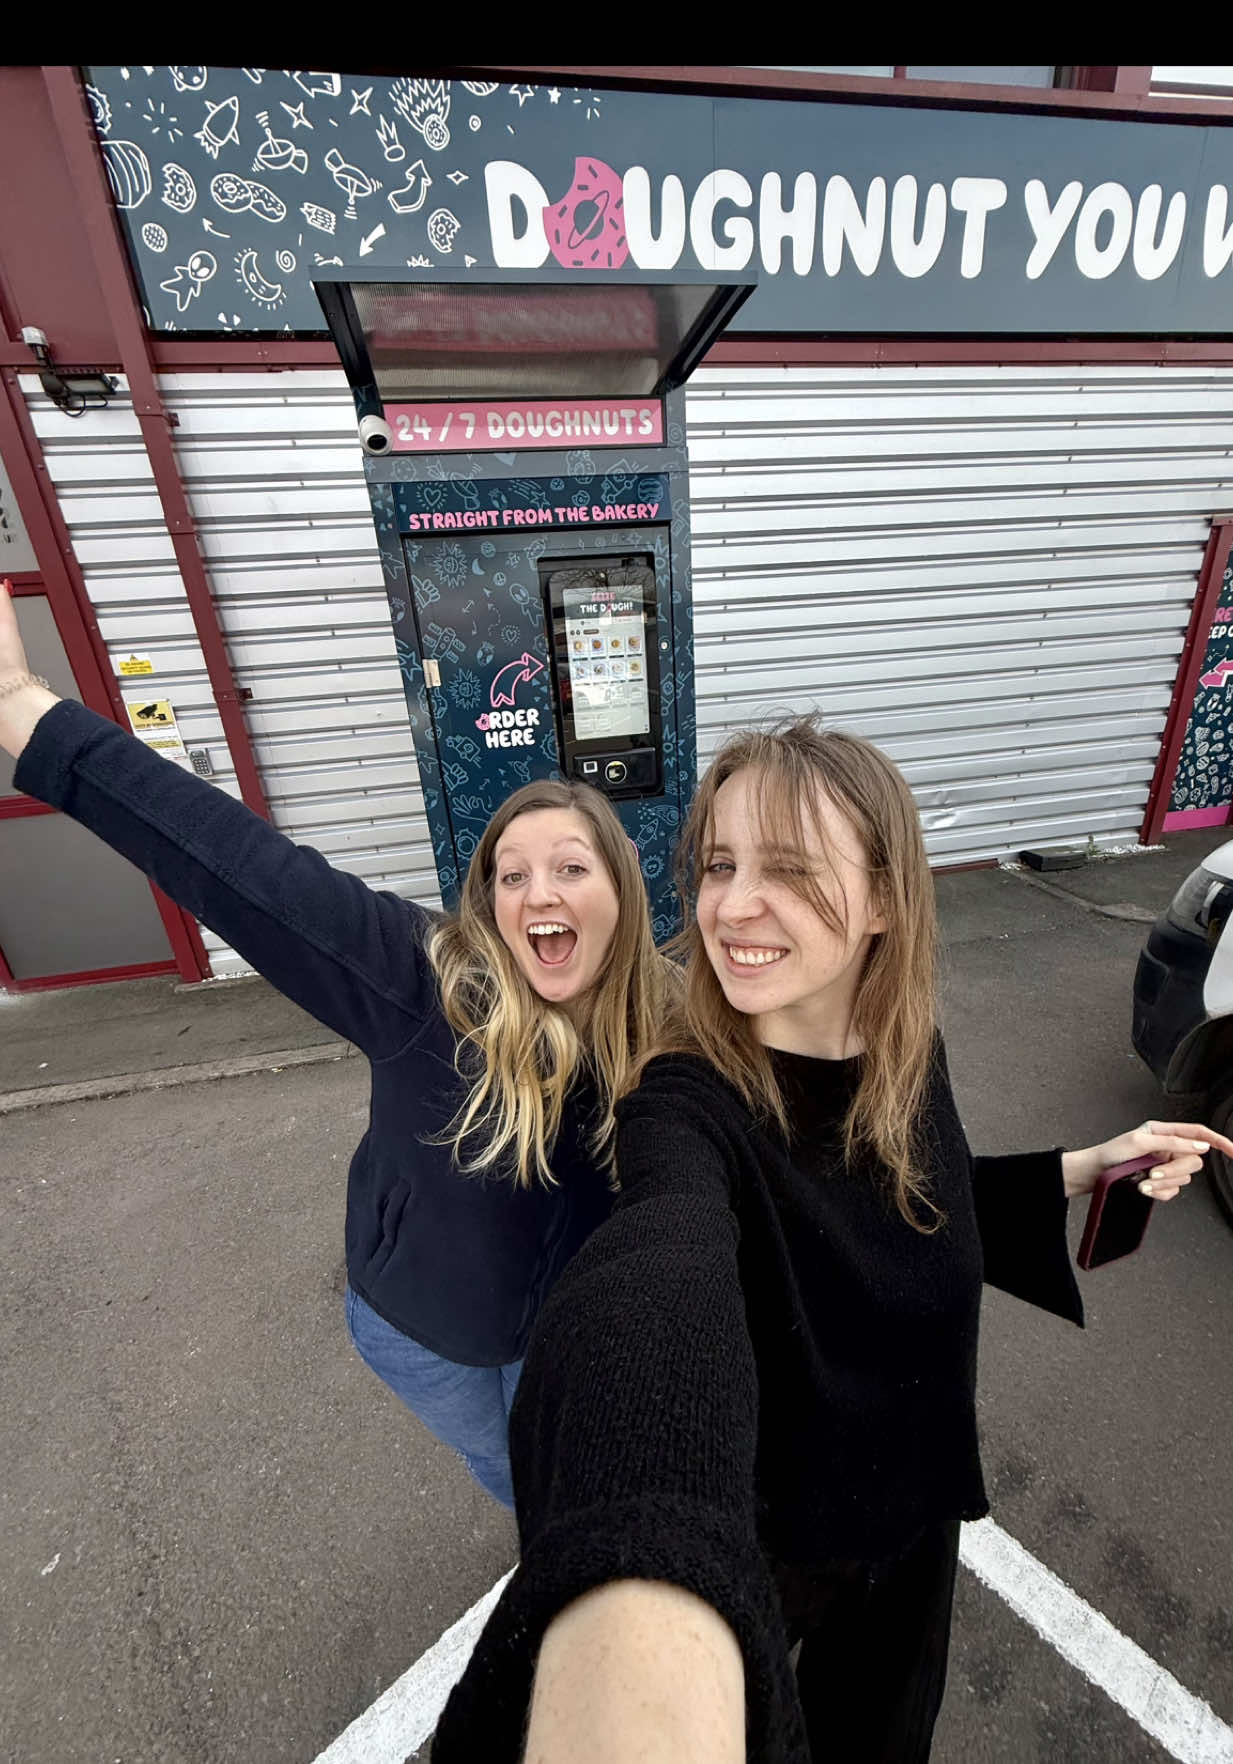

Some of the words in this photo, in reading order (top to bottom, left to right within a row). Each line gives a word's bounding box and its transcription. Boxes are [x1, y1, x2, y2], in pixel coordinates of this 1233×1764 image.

[1024, 178, 1186, 280] YOU
[487, 408, 653, 439] DOUGHNUTS
[409, 509, 500, 530] STRAIGHT
[503, 507, 553, 526] FROM
[555, 506, 590, 523] THE
[591, 502, 660, 522] BAKERY
[580, 604, 598, 614] THE
[485, 727, 536, 749] HERE
